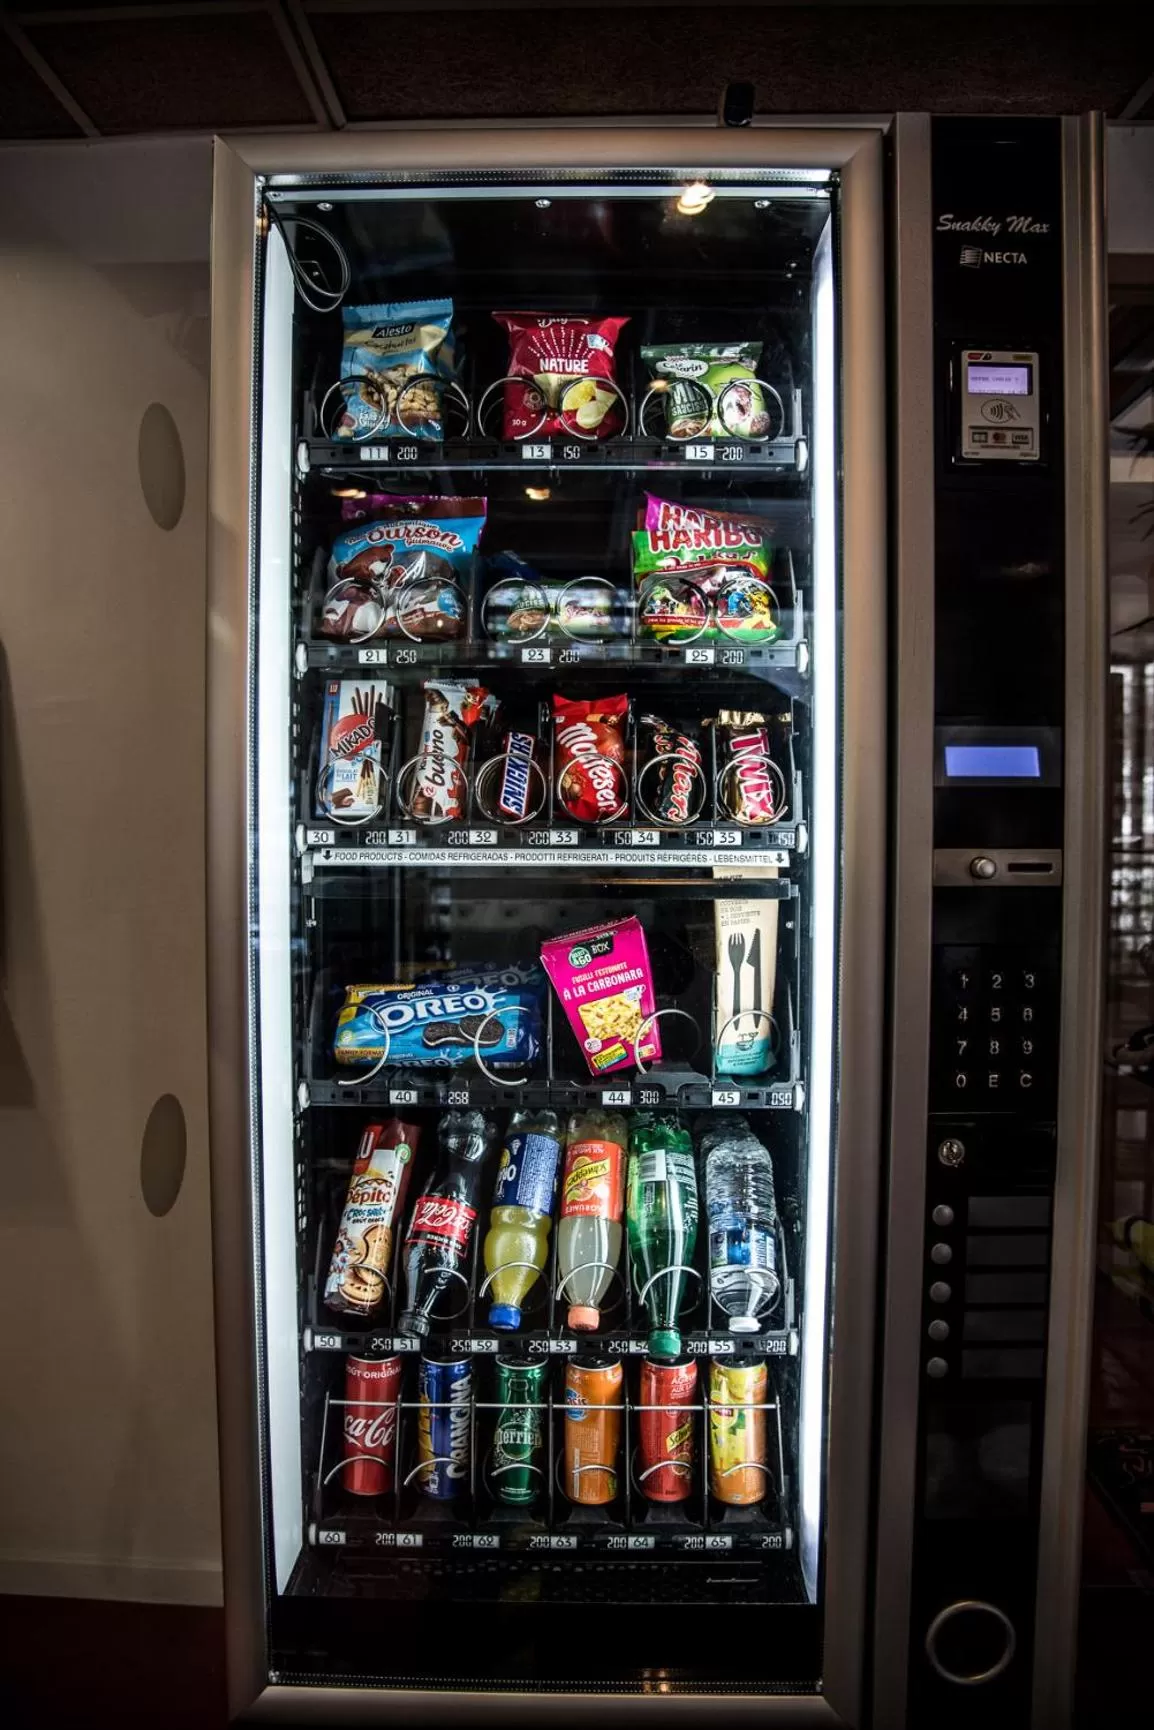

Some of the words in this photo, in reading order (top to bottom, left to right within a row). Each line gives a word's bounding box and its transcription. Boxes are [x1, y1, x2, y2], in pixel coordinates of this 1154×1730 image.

[936, 214, 1001, 236] Snakky
[1006, 216, 1051, 233] Max
[983, 252, 1027, 264] NECTA
[377, 323, 413, 337] Alesto
[540, 358, 589, 373] NATURE
[370, 447, 381, 460] 11
[529, 446, 545, 458] 13
[693, 447, 707, 457] 15
[366, 526, 464, 548] Ourson
[649, 530, 763, 552] HARIBO
[365, 651, 380, 662] 21
[528, 650, 544, 662] 23
[691, 650, 708, 662] 25
[425, 729, 445, 786] bueno
[556, 722, 617, 811] Malteser
[313, 832, 329, 843] 30
[395, 831, 410, 842] 31
[475, 832, 491, 843] 32
[556, 832, 572, 843] 33
[638, 832, 653, 843] 34
[719, 832, 736, 843] 35
[335, 852, 358, 861] FOOD
[360, 852, 403, 861] PRODUCTS
[409, 852, 446, 861] COMIDAS
[448, 852, 508, 861] REFRIGERADAS
[515, 853, 555, 861] PRODOTTI
[615, 853, 655, 862] PRODUITS
[714, 854, 773, 863] LEBENSMITTEL
[573, 985, 586, 998] LA
[588, 967, 644, 993] CARBONARA
[992, 974, 1001, 988] 2
[1025, 974, 1035, 988] 3
[397, 989, 435, 1000] ORIGINAL
[379, 994, 485, 1028] OREO
[958, 1007, 968, 1021] 4
[991, 1007, 1001, 1021] 5
[957, 1040, 967, 1055] 7
[990, 1040, 999, 1054] 8
[1023, 1040, 1033, 1054] 9
[956, 1074, 966, 1088] 0
[989, 1074, 999, 1087] E
[1020, 1073, 1032, 1087] C
[395, 1091, 412, 1102] 40
[608, 1092, 625, 1103] 44
[718, 1092, 735, 1104] 45
[320, 1336, 335, 1347] 50
[399, 1338, 414, 1349] 51
[477, 1340, 492, 1351] 52
[555, 1340, 571, 1351] 53
[714, 1340, 730, 1351] 55
[324, 1532, 340, 1543] 60
[402, 1533, 416, 1544] 61
[478, 1535, 493, 1546] 62
[556, 1536, 572, 1547] 63
[633, 1537, 648, 1548] 64
[711, 1537, 726, 1548] 65
